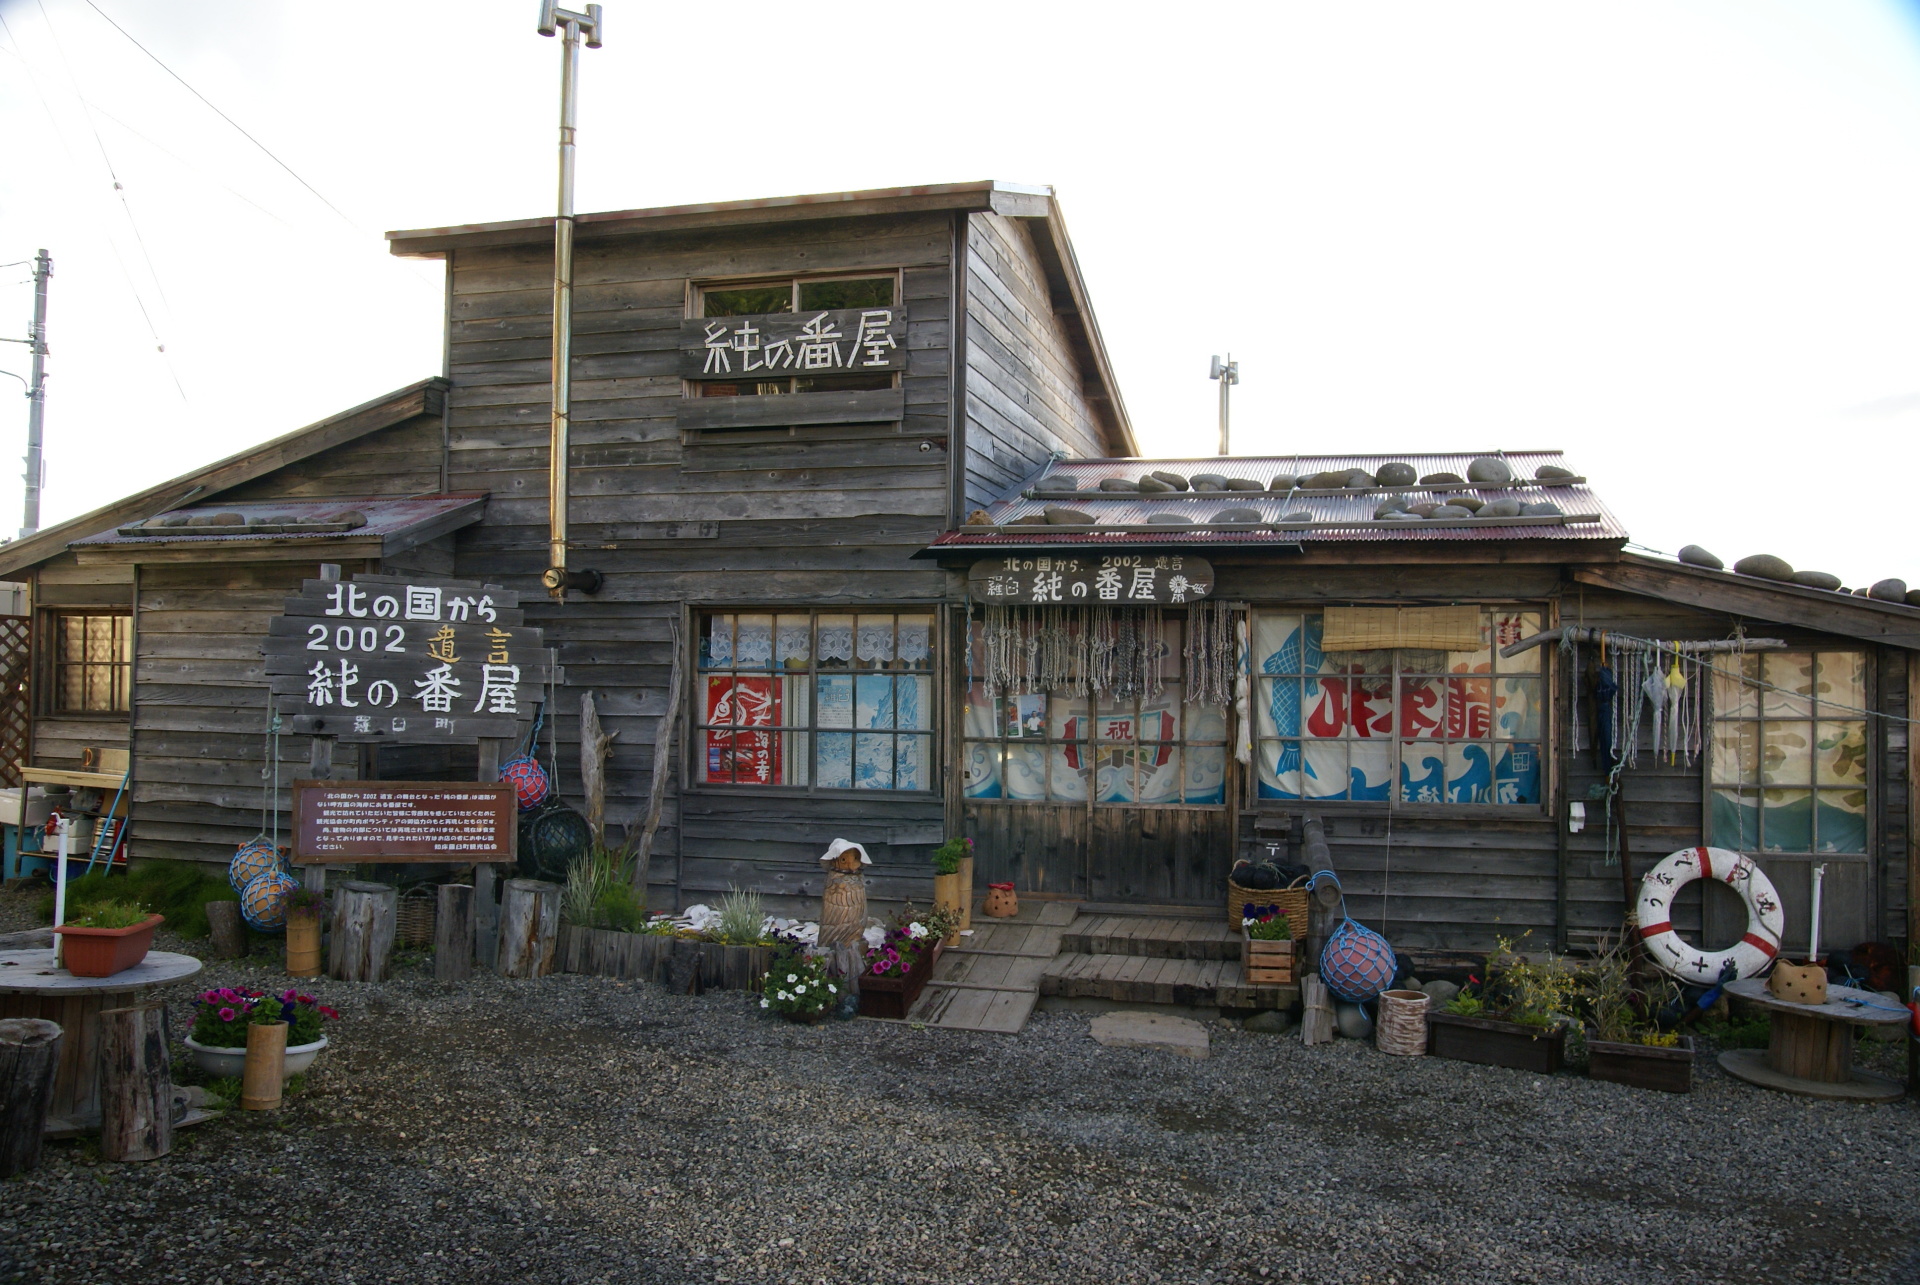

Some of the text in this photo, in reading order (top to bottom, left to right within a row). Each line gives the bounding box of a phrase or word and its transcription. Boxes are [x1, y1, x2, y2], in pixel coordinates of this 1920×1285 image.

[703, 310, 897, 374] 純の番屋
[325, 583, 497, 623] 北の国から
[1032, 567, 1157, 602] 純の番屋
[306, 624, 512, 664] 2002 遺言
[307, 658, 521, 715] 純の番屋
[353, 715, 456, 735] 羅臼町
[1105, 721, 1133, 740] 祝
